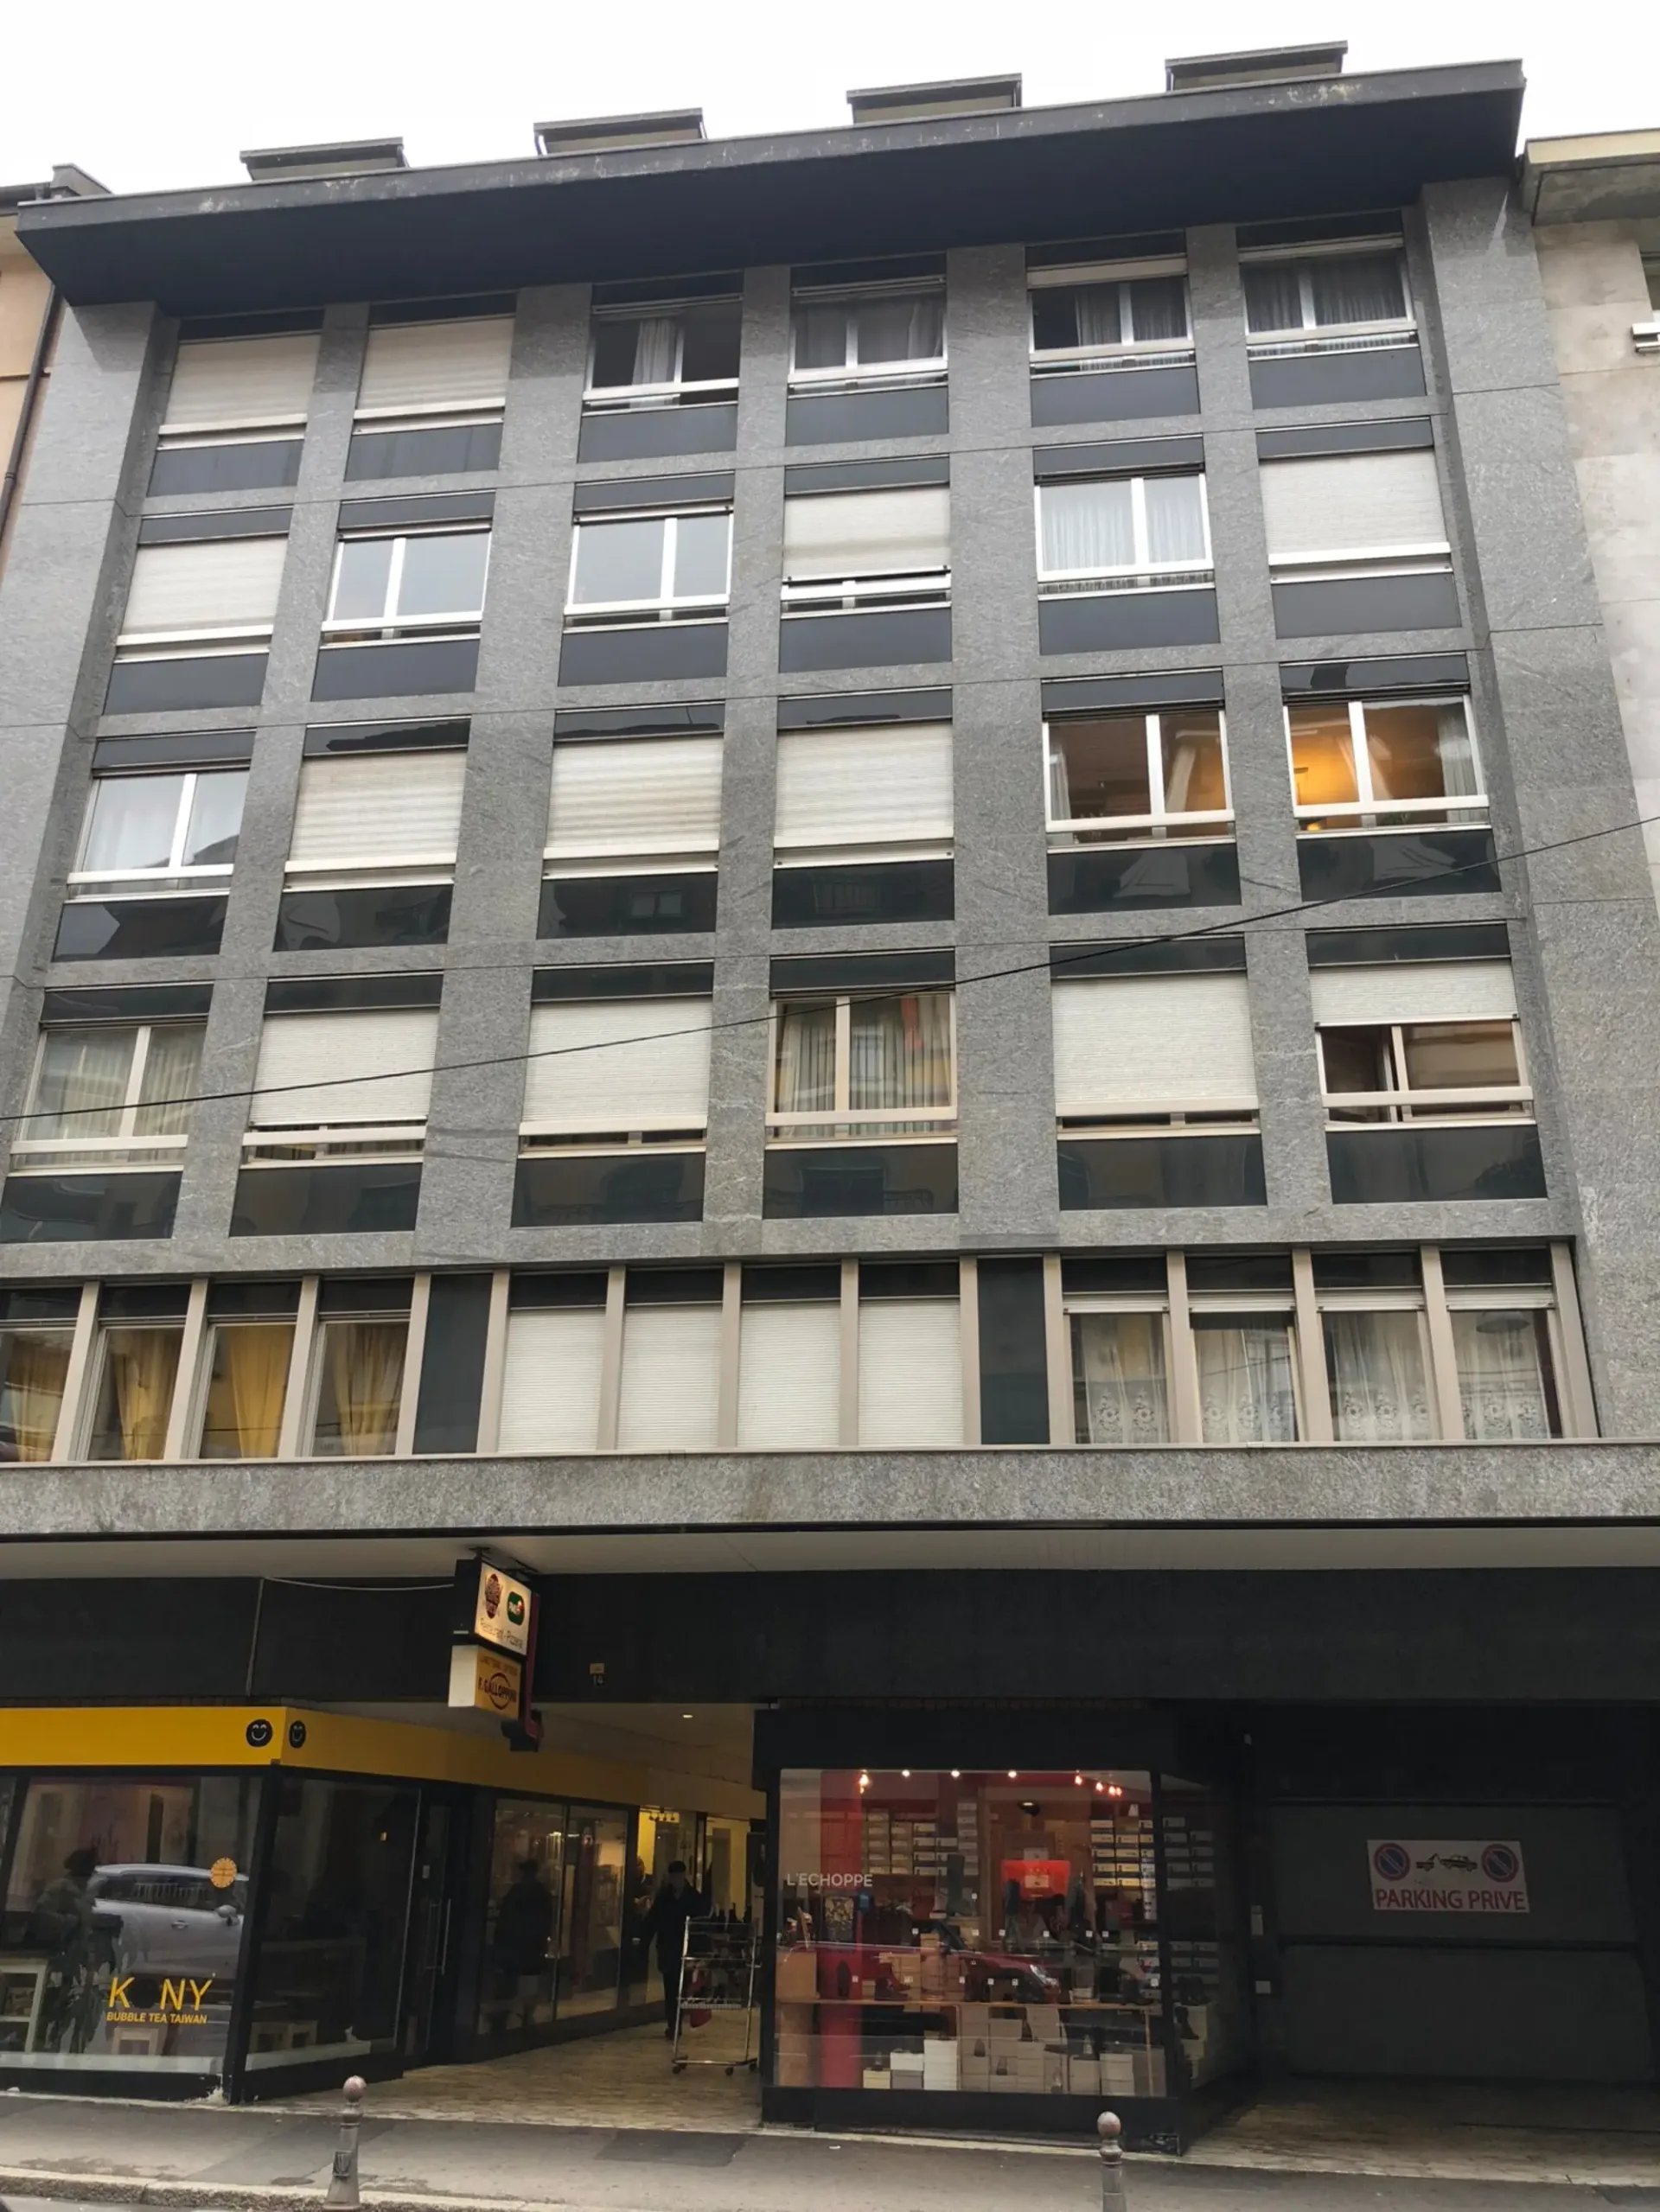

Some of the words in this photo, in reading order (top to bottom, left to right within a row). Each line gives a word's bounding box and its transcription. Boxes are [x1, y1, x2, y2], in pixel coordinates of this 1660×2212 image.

[787, 1872, 873, 1887] L'ECHOPPE
[1375, 1889, 1464, 1909] PARKING
[1468, 1890, 1526, 1910] PRIVE
[106, 2011, 147, 2023] BUBBLE
[149, 2012, 167, 2024] TEA
[169, 2013, 208, 2024] TAIWAN
